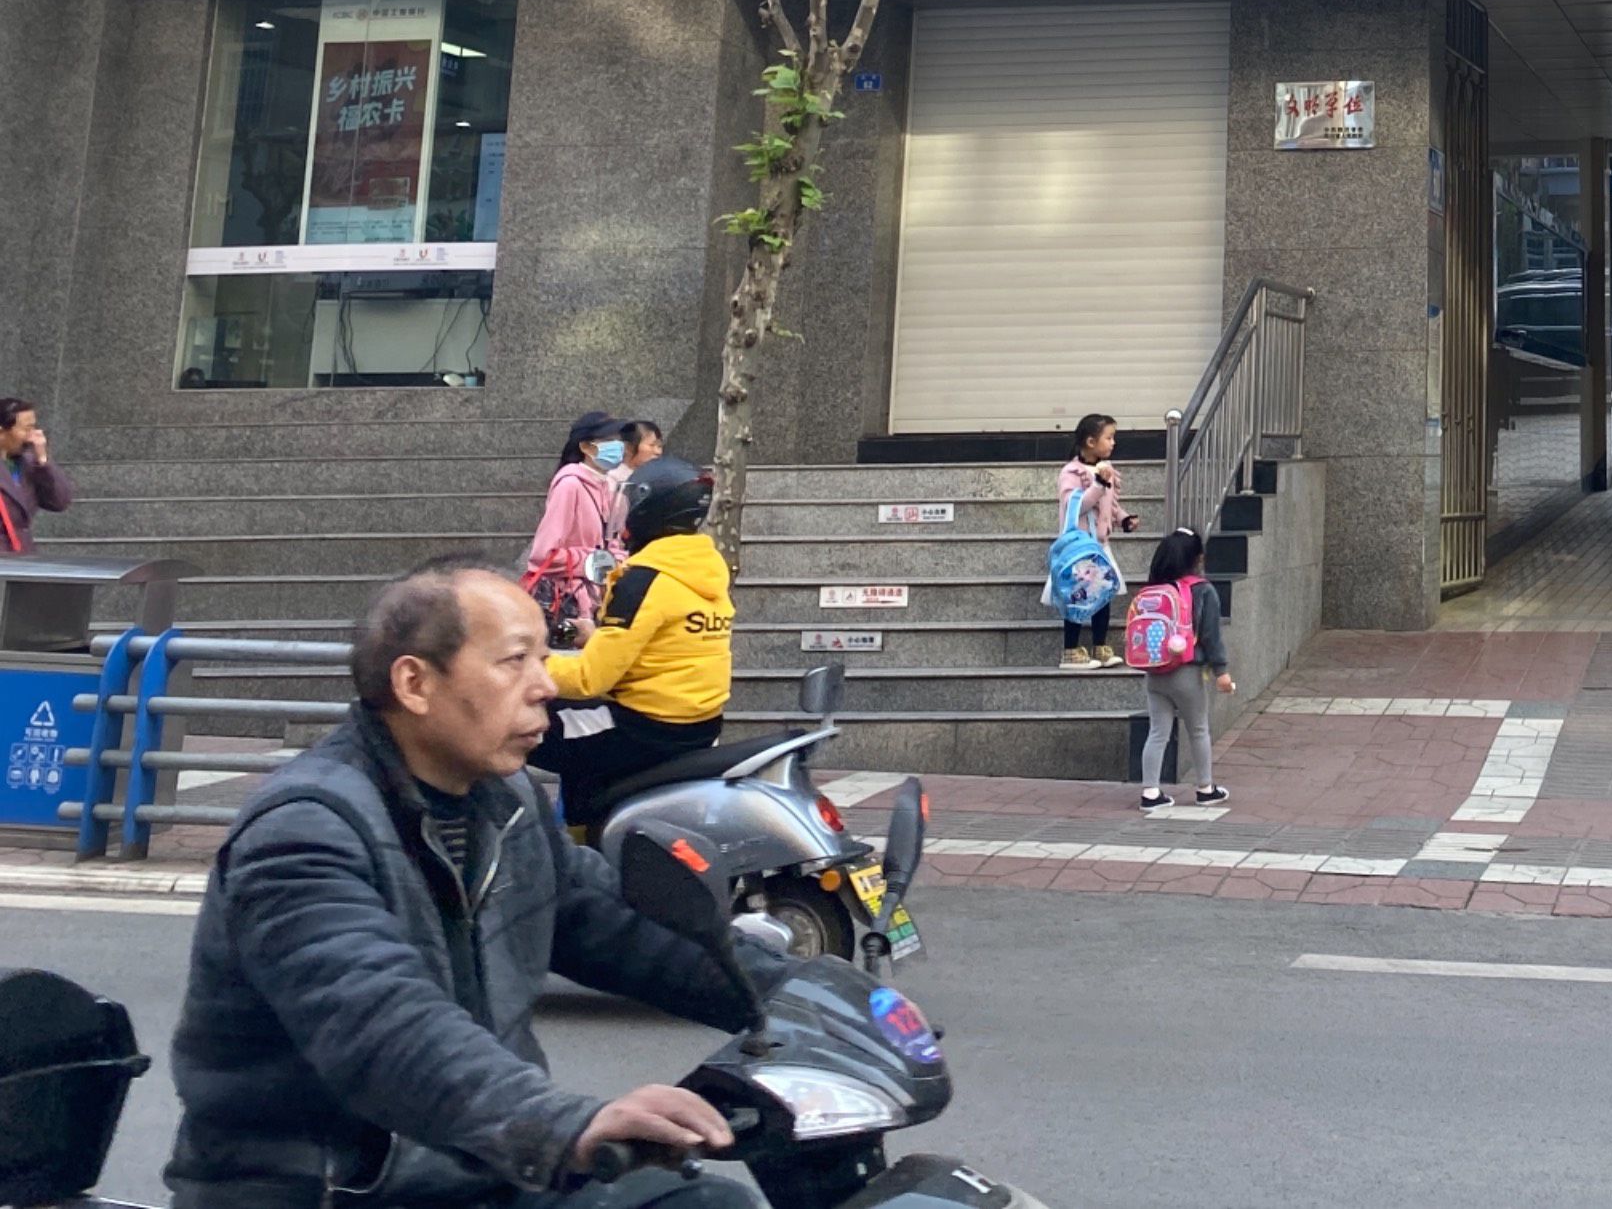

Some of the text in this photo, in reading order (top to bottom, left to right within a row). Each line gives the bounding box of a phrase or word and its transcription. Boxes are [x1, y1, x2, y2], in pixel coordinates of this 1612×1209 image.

[326, 66, 417, 103] 乡村振兴
[338, 97, 405, 132] 福农卡
[1286, 91, 1363, 119] 文明单位
